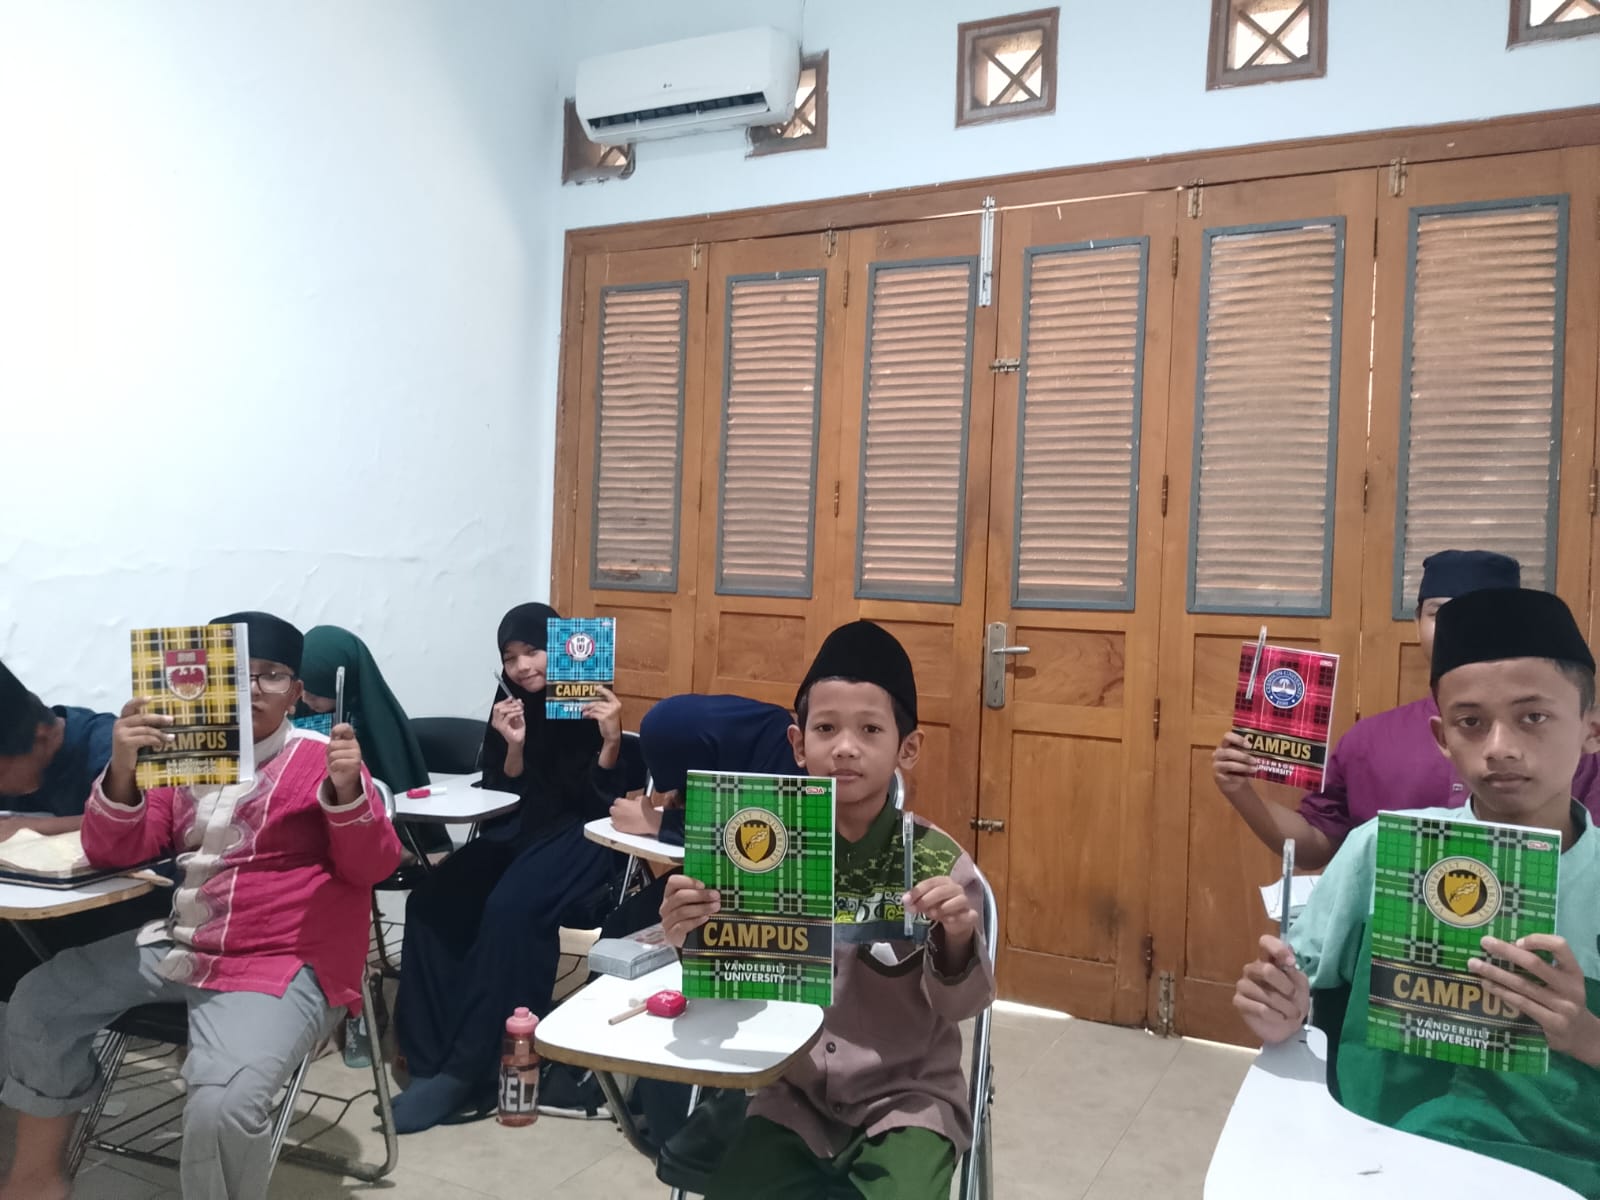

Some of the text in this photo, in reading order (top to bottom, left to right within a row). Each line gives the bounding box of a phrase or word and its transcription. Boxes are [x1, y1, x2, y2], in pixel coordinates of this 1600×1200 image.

[555, 684, 602, 697] CAMPU
[703, 921, 809, 952] CAMPUS
[724, 962, 786, 974] VANDERBILT
[724, 972, 786, 984] UNIVERSITY
[1416, 1018, 1490, 1039] VANDERBILT
[1416, 1028, 1490, 1050] UNIVERSITY
